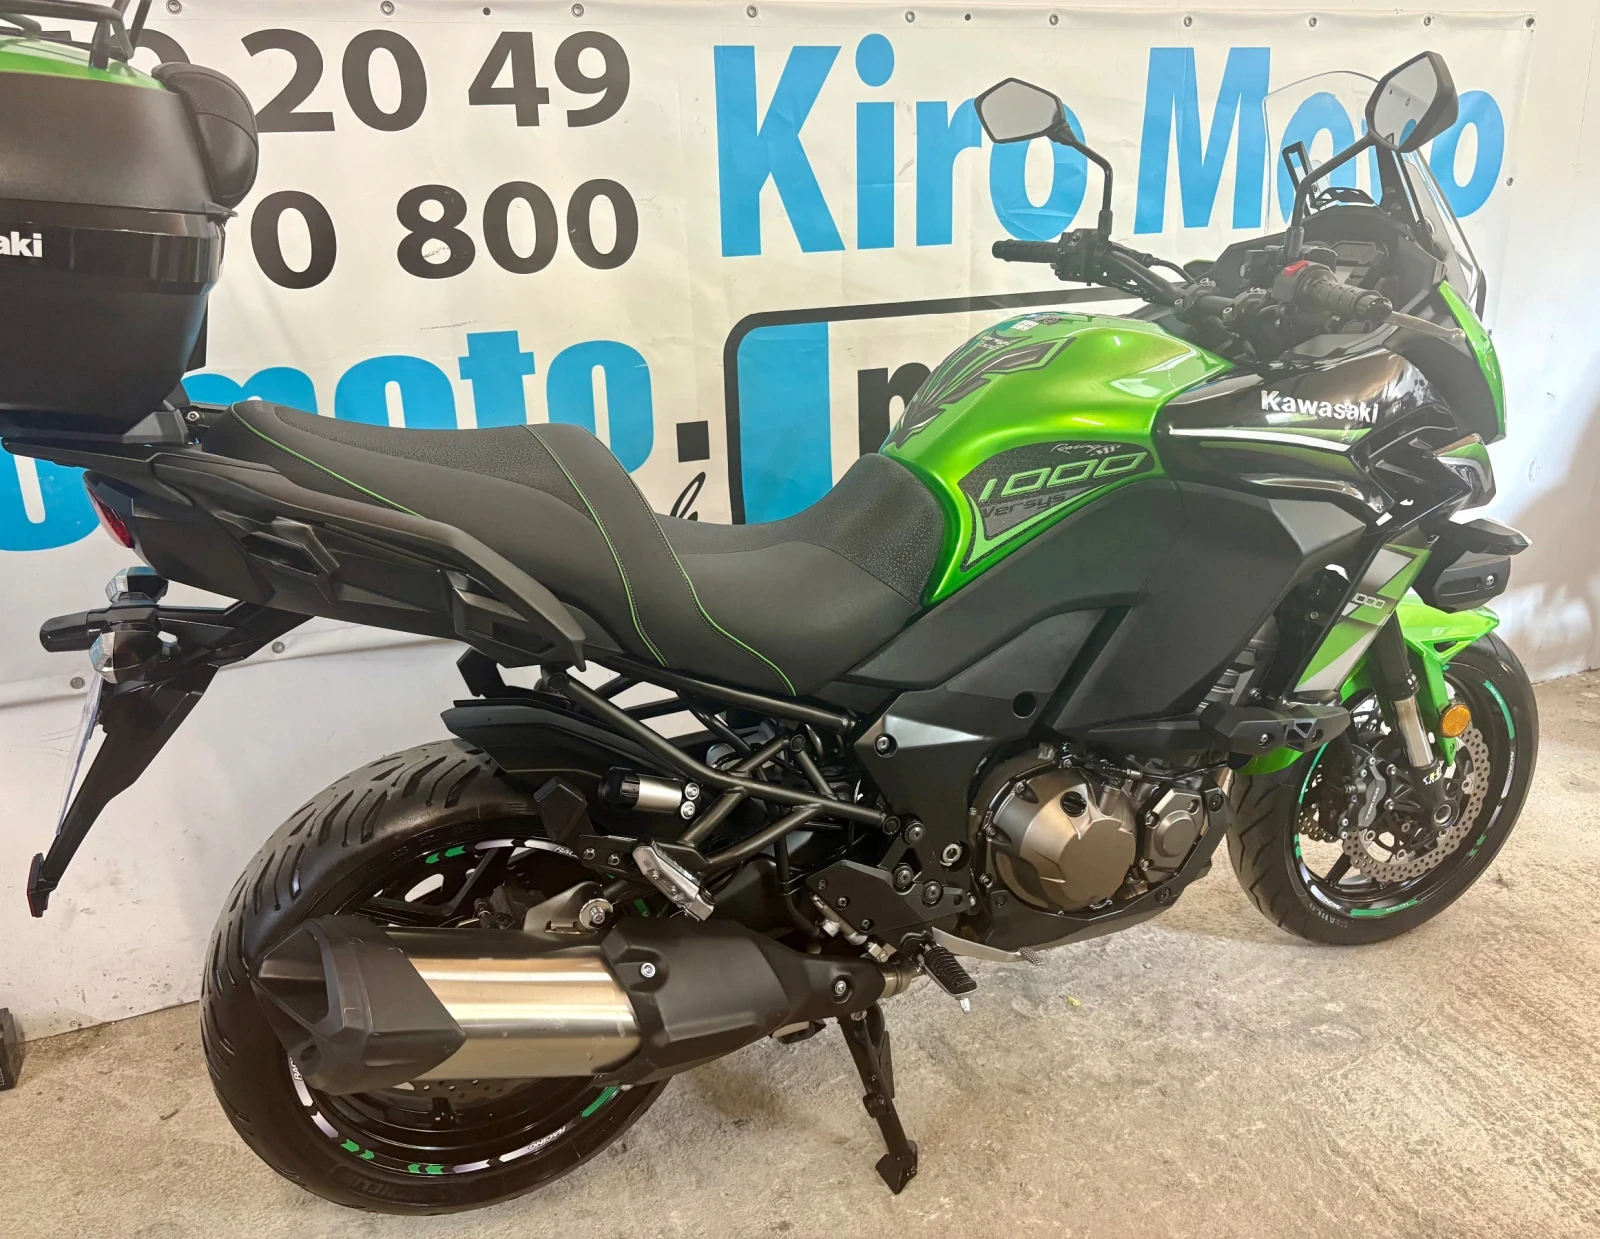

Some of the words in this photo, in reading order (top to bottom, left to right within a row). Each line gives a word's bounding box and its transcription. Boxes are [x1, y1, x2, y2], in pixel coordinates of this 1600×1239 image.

[241, 29, 427, 132] 20
[468, 31, 630, 127] 49
[714, 33, 1088, 257] Kiro
[397, 179, 638, 279] 800
[1261, 390, 1379, 424] Kawasaki
[978, 452, 1148, 503] 1000
[1352, 592, 1386, 610] 1000
[527, 1126, 567, 1150] RACING
